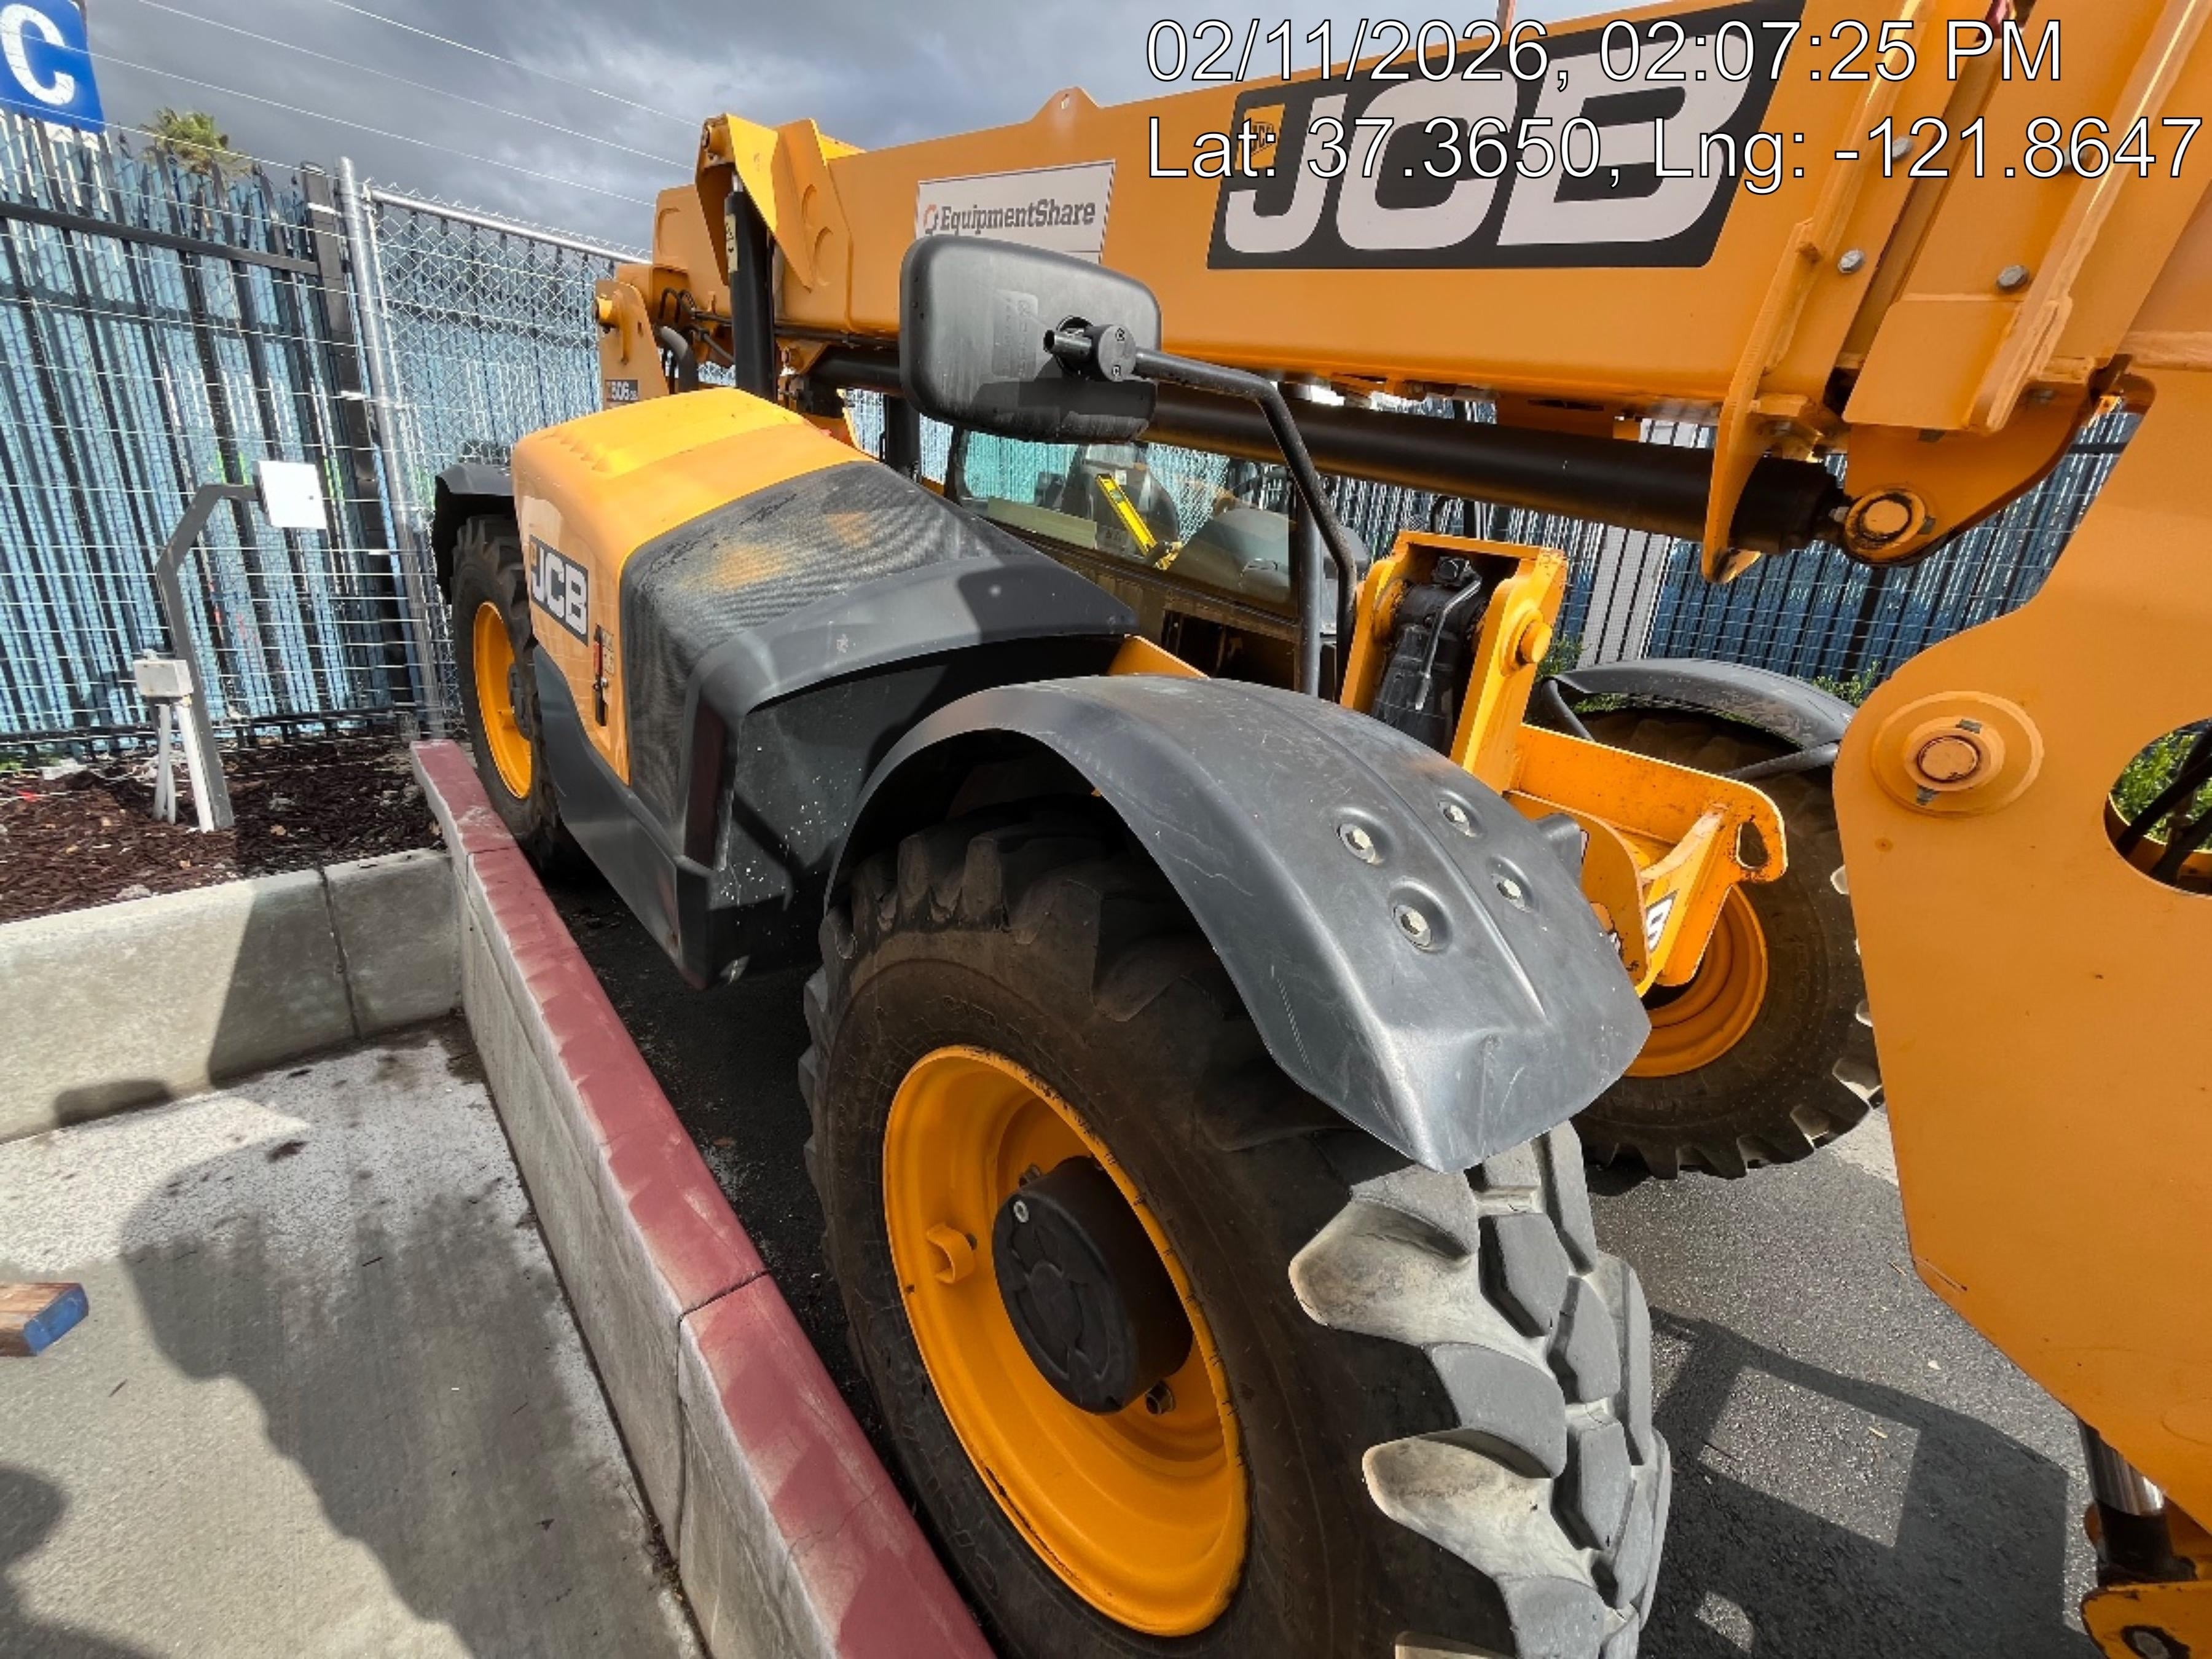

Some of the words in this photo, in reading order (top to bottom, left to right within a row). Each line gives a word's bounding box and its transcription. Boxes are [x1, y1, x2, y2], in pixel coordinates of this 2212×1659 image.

[1, 3, 75, 106] C
[1225, 34, 1752, 253] JCB
[940, 198, 1096, 235] EquipmentShare
[531, 546, 587, 635] JCB
